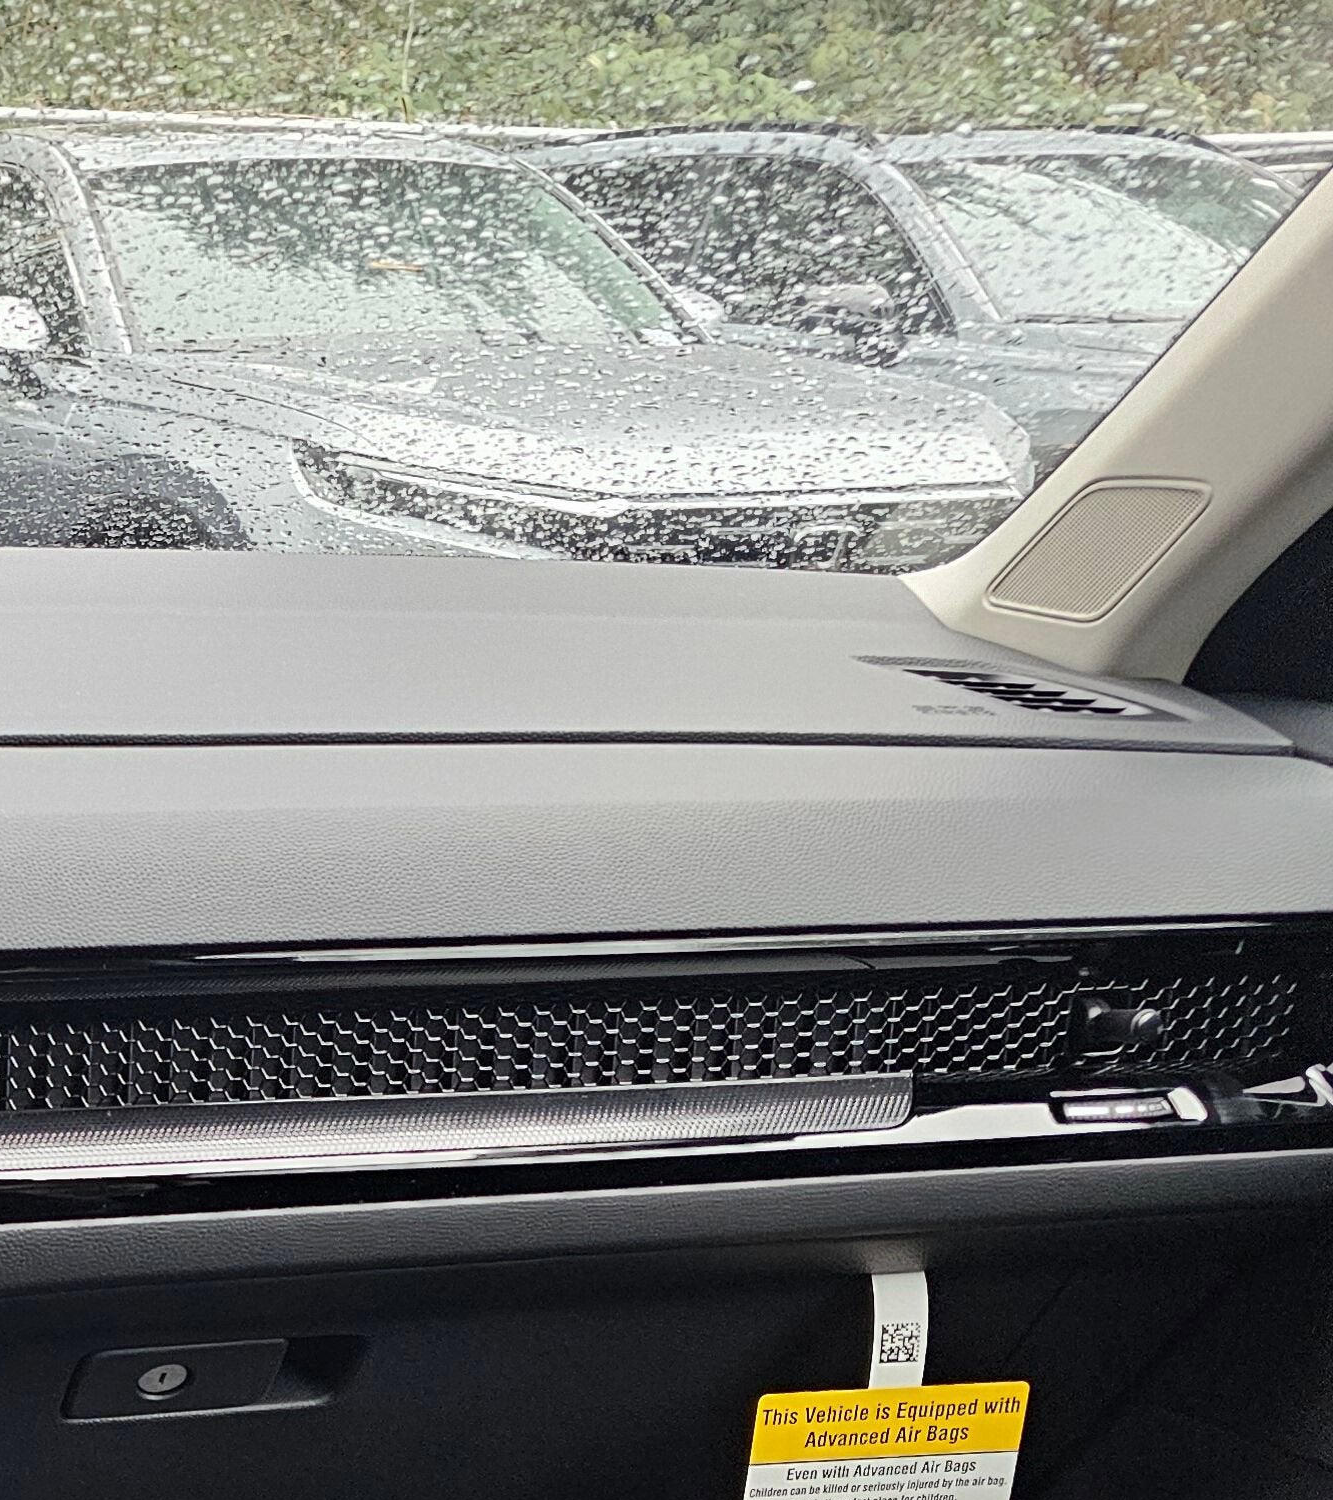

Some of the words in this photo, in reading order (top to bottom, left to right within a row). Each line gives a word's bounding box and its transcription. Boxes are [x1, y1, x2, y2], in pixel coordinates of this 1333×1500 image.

[763, 1408, 798, 1425] This
[806, 1405, 869, 1423] Vehicle
[876, 1403, 890, 1420] is
[897, 1399, 978, 1421] Equipped
[984, 1397, 1020, 1414] with
[804, 1428, 890, 1448] Advanced
[895, 1426, 921, 1443] Air
[927, 1425, 969, 1444] Bags
[786, 1467, 817, 1481] Even
[822, 1465, 850, 1478] with
[853, 1461, 917, 1477] Advanced
[921, 1461, 941, 1474] Air
[944, 1460, 977, 1474] Bags
[749, 1488, 788, 1497] Children
[790, 1487, 806, 1496] can
[809, 1486, 820, 1495] be
[823, 1483, 848, 1493] killed
[851, 1484, 861, 1492] or
[862, 1481, 904, 1492] seriously
[907, 1479, 939, 1491] injured
[942, 1478, 953, 1490] by
[955, 1477, 970, 1487] the
[972, 1477, 985, 1486] air
[987, 1476, 1007, 1487] bag.
